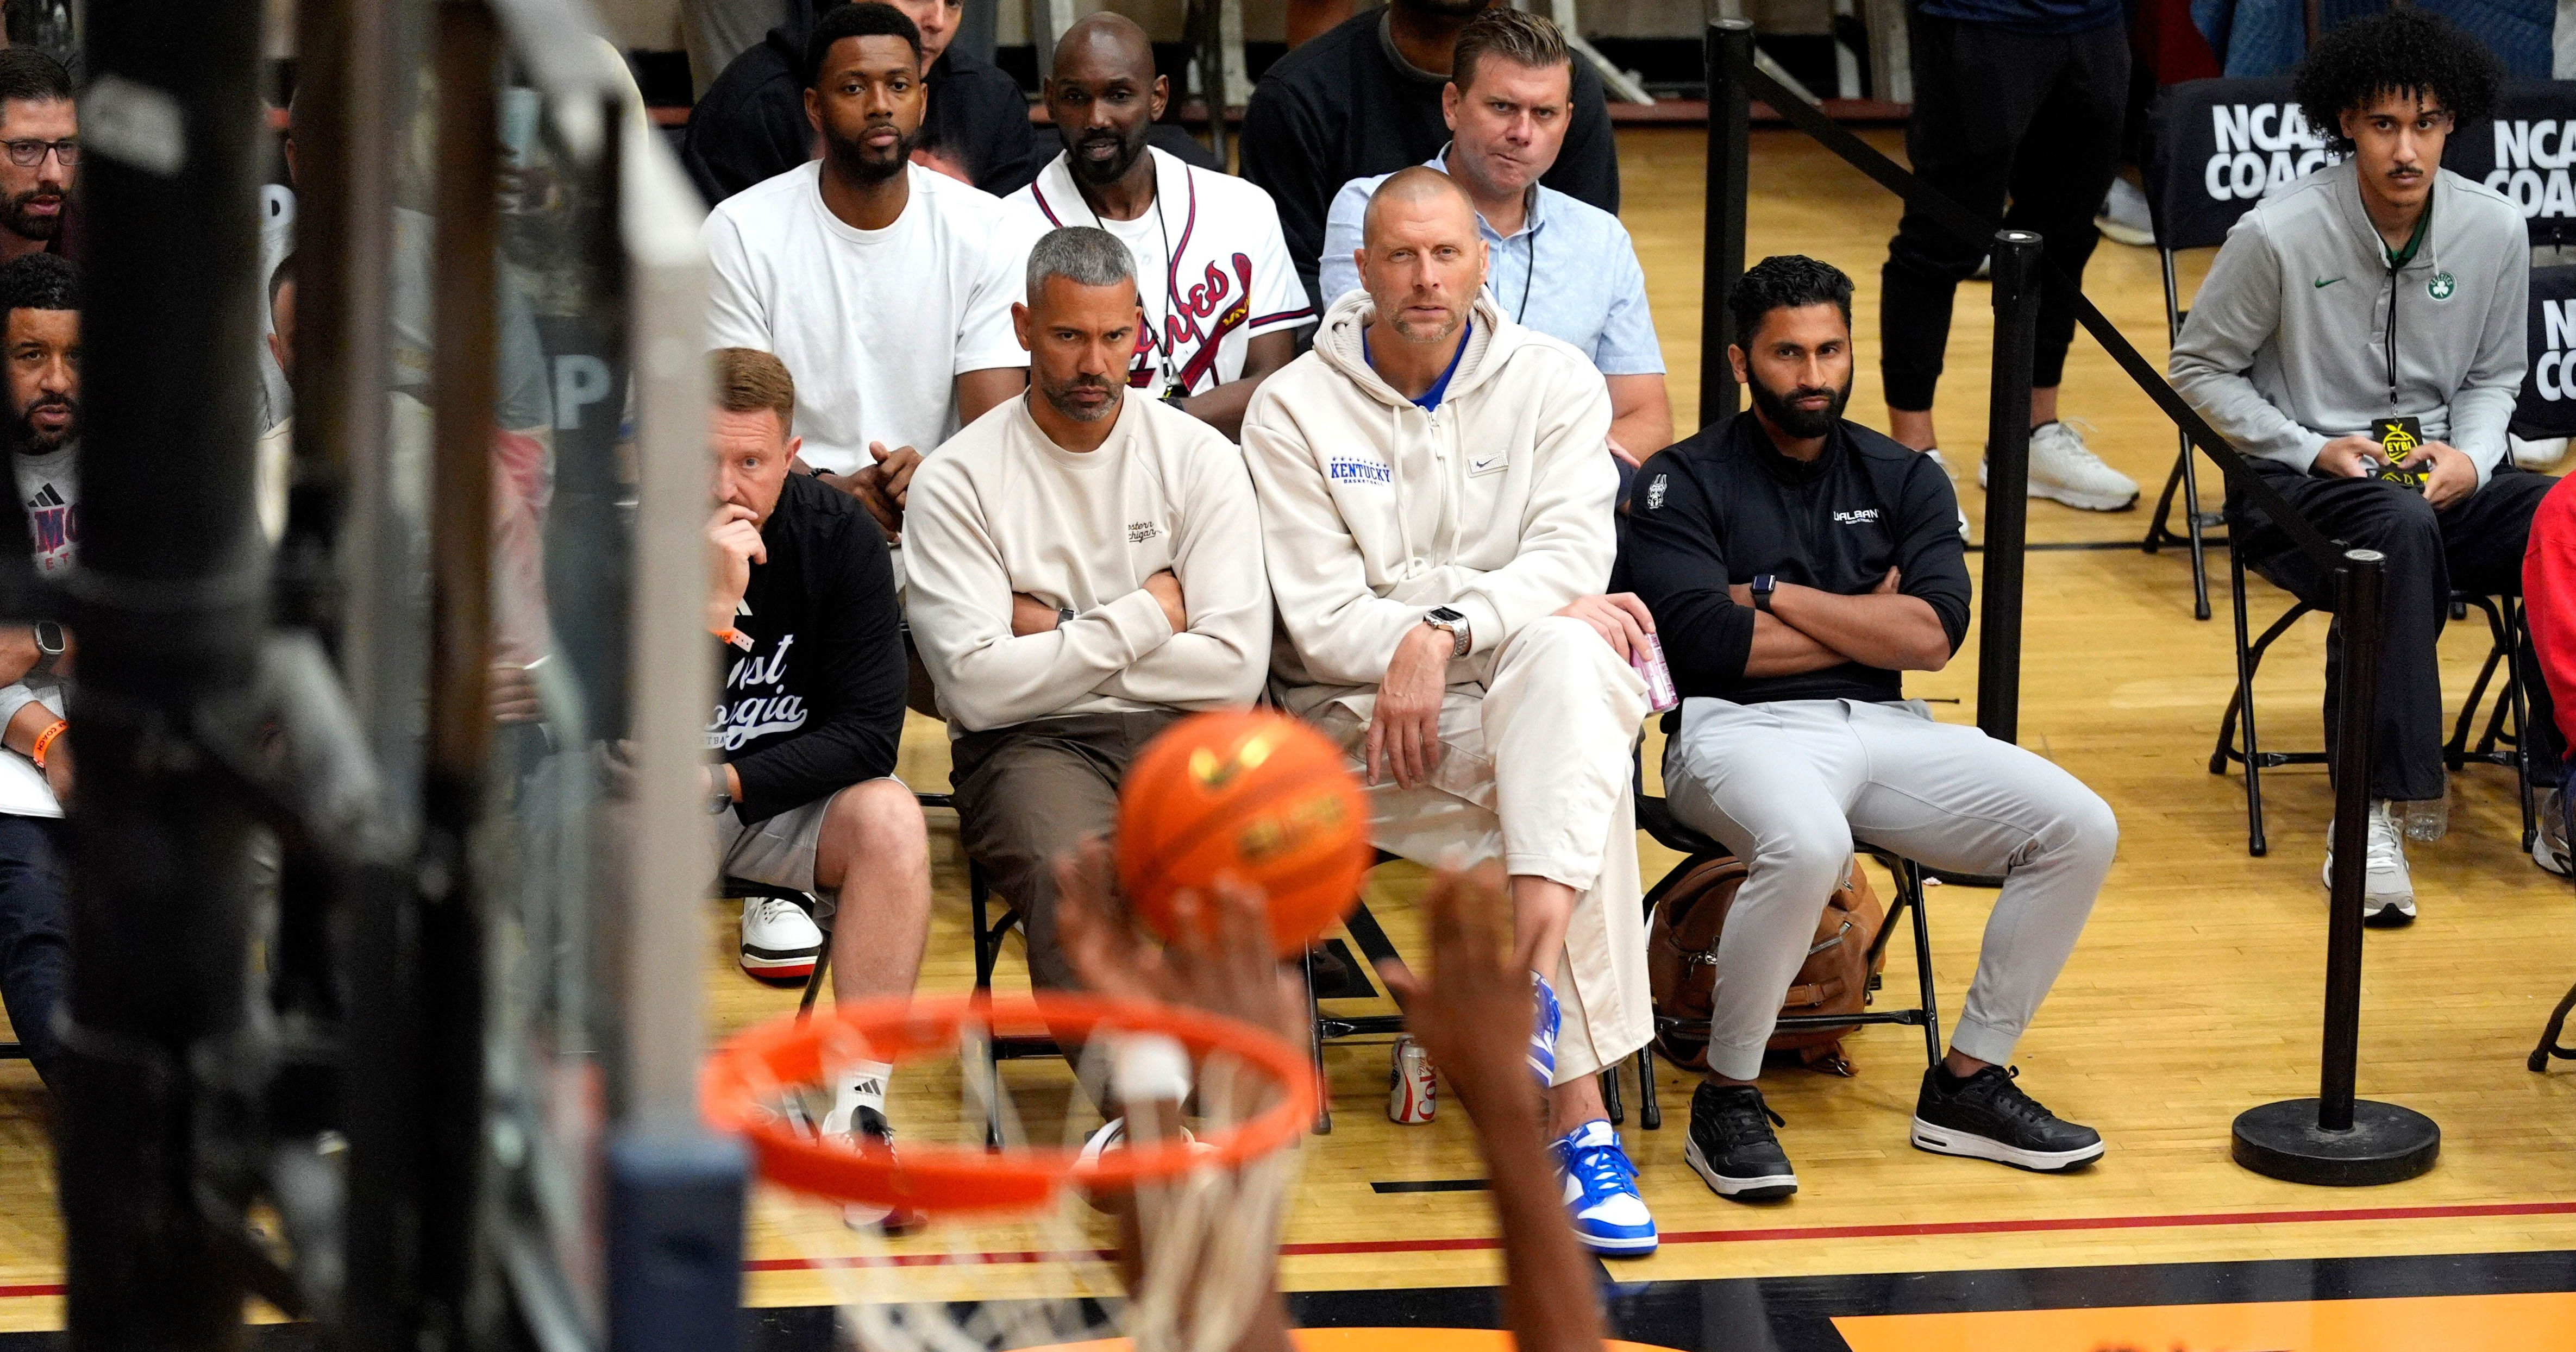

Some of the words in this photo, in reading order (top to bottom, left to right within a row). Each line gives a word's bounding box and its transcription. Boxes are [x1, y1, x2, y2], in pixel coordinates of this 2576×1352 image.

[1331, 463, 1390, 482] KENTUCKY
[1833, 508, 1879, 521] UALBAN
[37, 728, 57, 751] COACH
[1418, 1066, 1436, 1120] Cok
